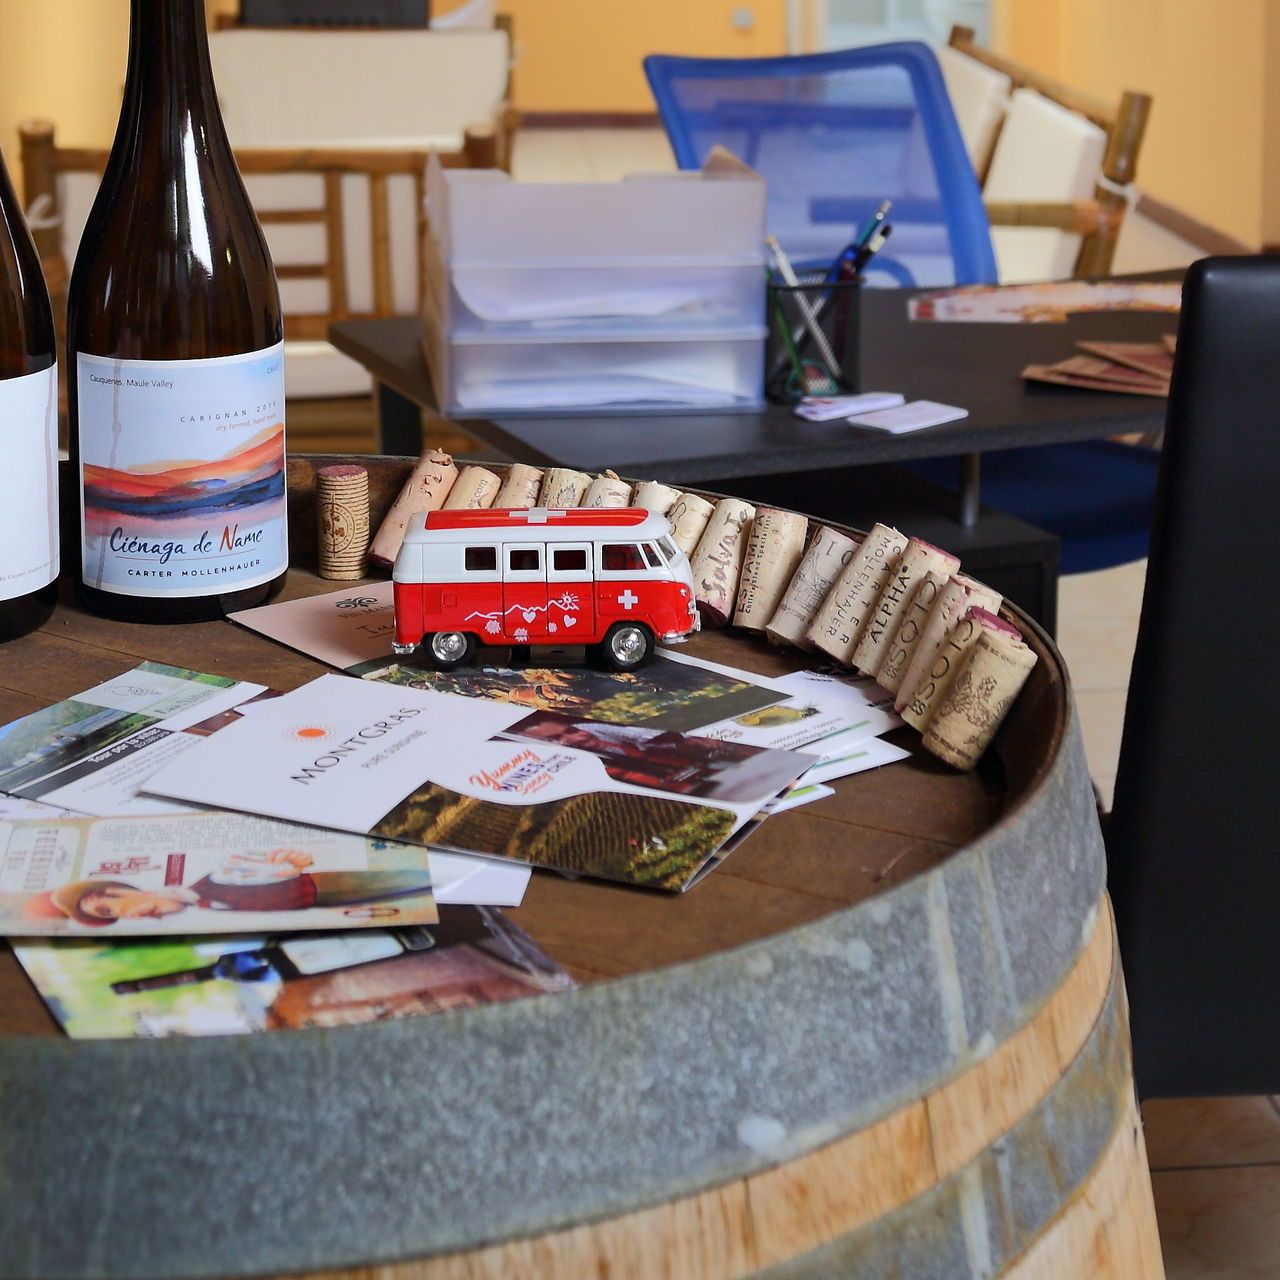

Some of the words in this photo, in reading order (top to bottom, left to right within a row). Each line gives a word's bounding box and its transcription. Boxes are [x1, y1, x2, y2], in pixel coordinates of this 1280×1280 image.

[126, 379, 150, 388] Maule
[151, 380, 174, 389] Valley
[180, 409, 248, 423] CARIGNAN
[110, 527, 187, 564] Ciénaga
[193, 530, 213, 554] de
[220, 524, 264, 553] Name
[128, 569, 173, 578] CARTER
[181, 559, 261, 578] MOLLENHAUER
[826, 536, 891, 637] MOLLENHAUER
[839, 545, 902, 645] CARTER
[870, 574, 911, 644] ALPHA
[289, 706, 422, 786] MONTGRAS
[469, 748, 542, 792] Yummy
